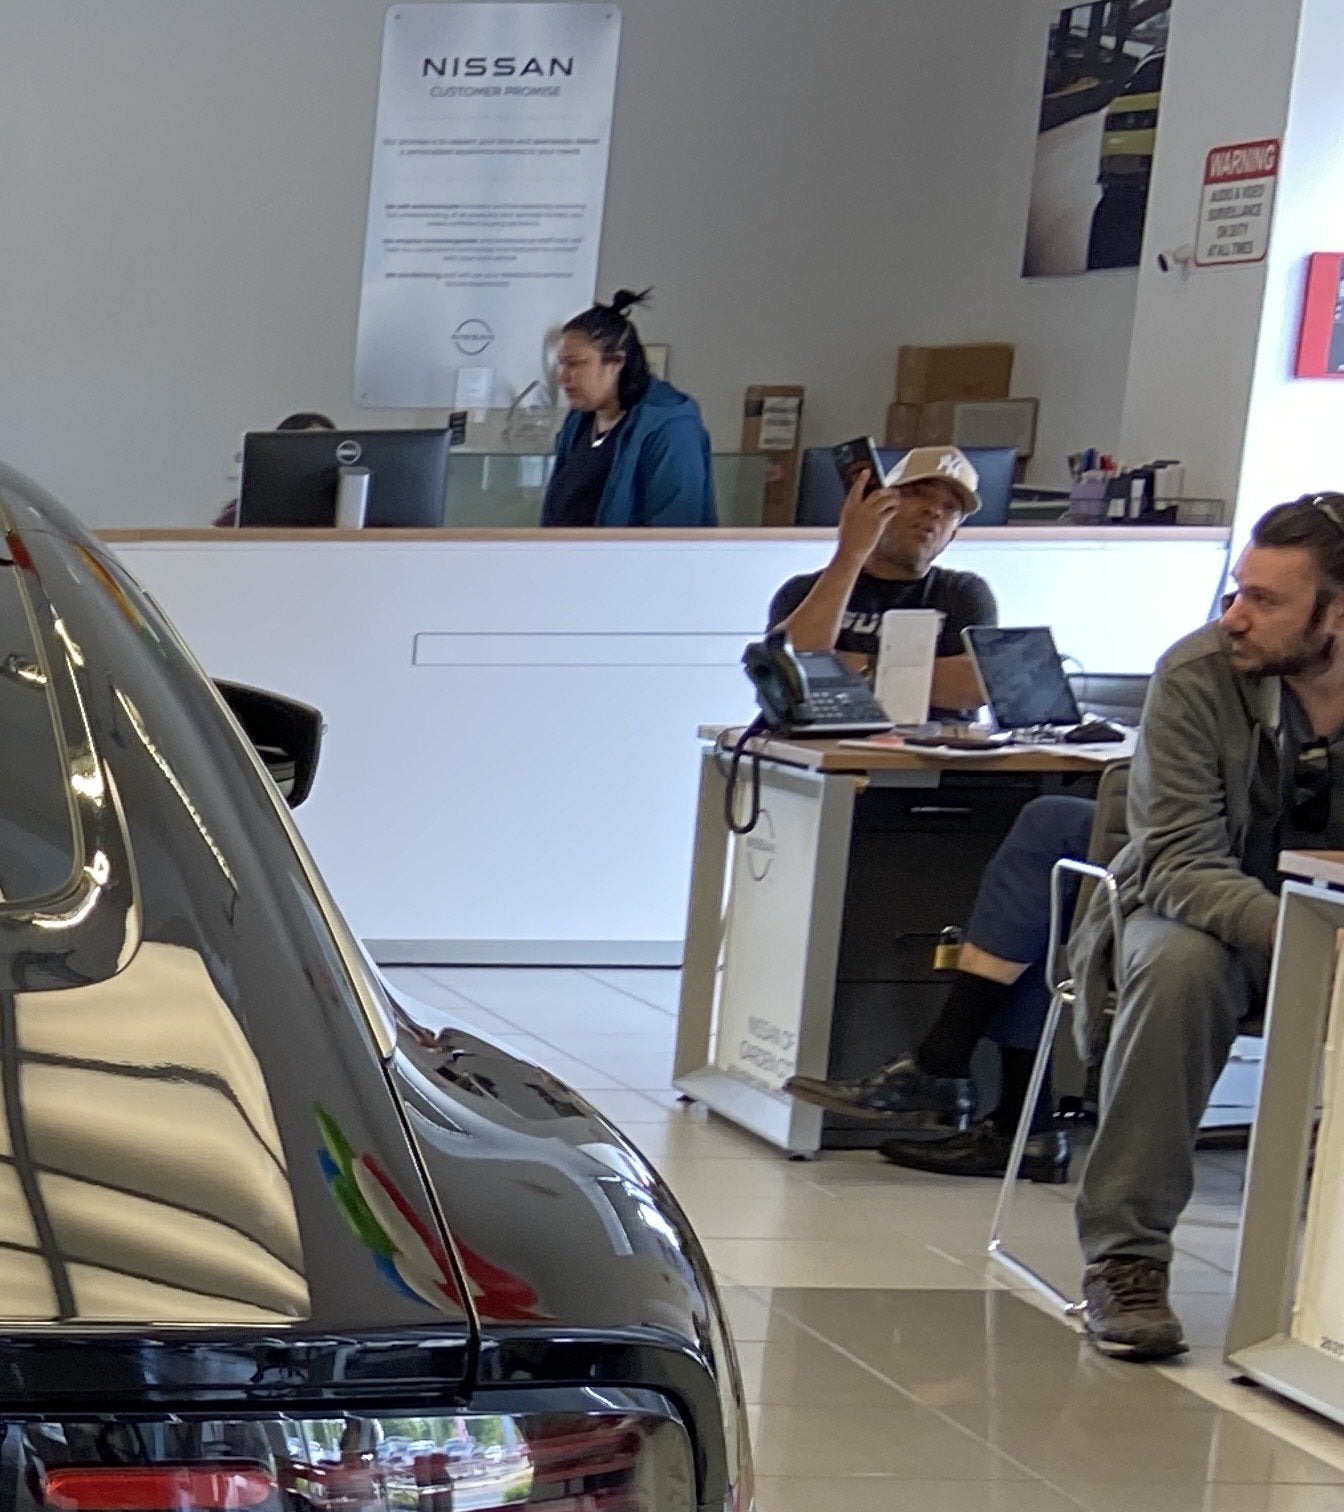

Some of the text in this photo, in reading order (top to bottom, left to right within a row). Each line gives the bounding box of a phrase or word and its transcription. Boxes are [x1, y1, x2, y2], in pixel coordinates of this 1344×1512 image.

[422, 57, 574, 78] NISSAN
[429, 85, 561, 98] CUSTOMER PROMISE
[1210, 144, 1276, 177] WARNING
